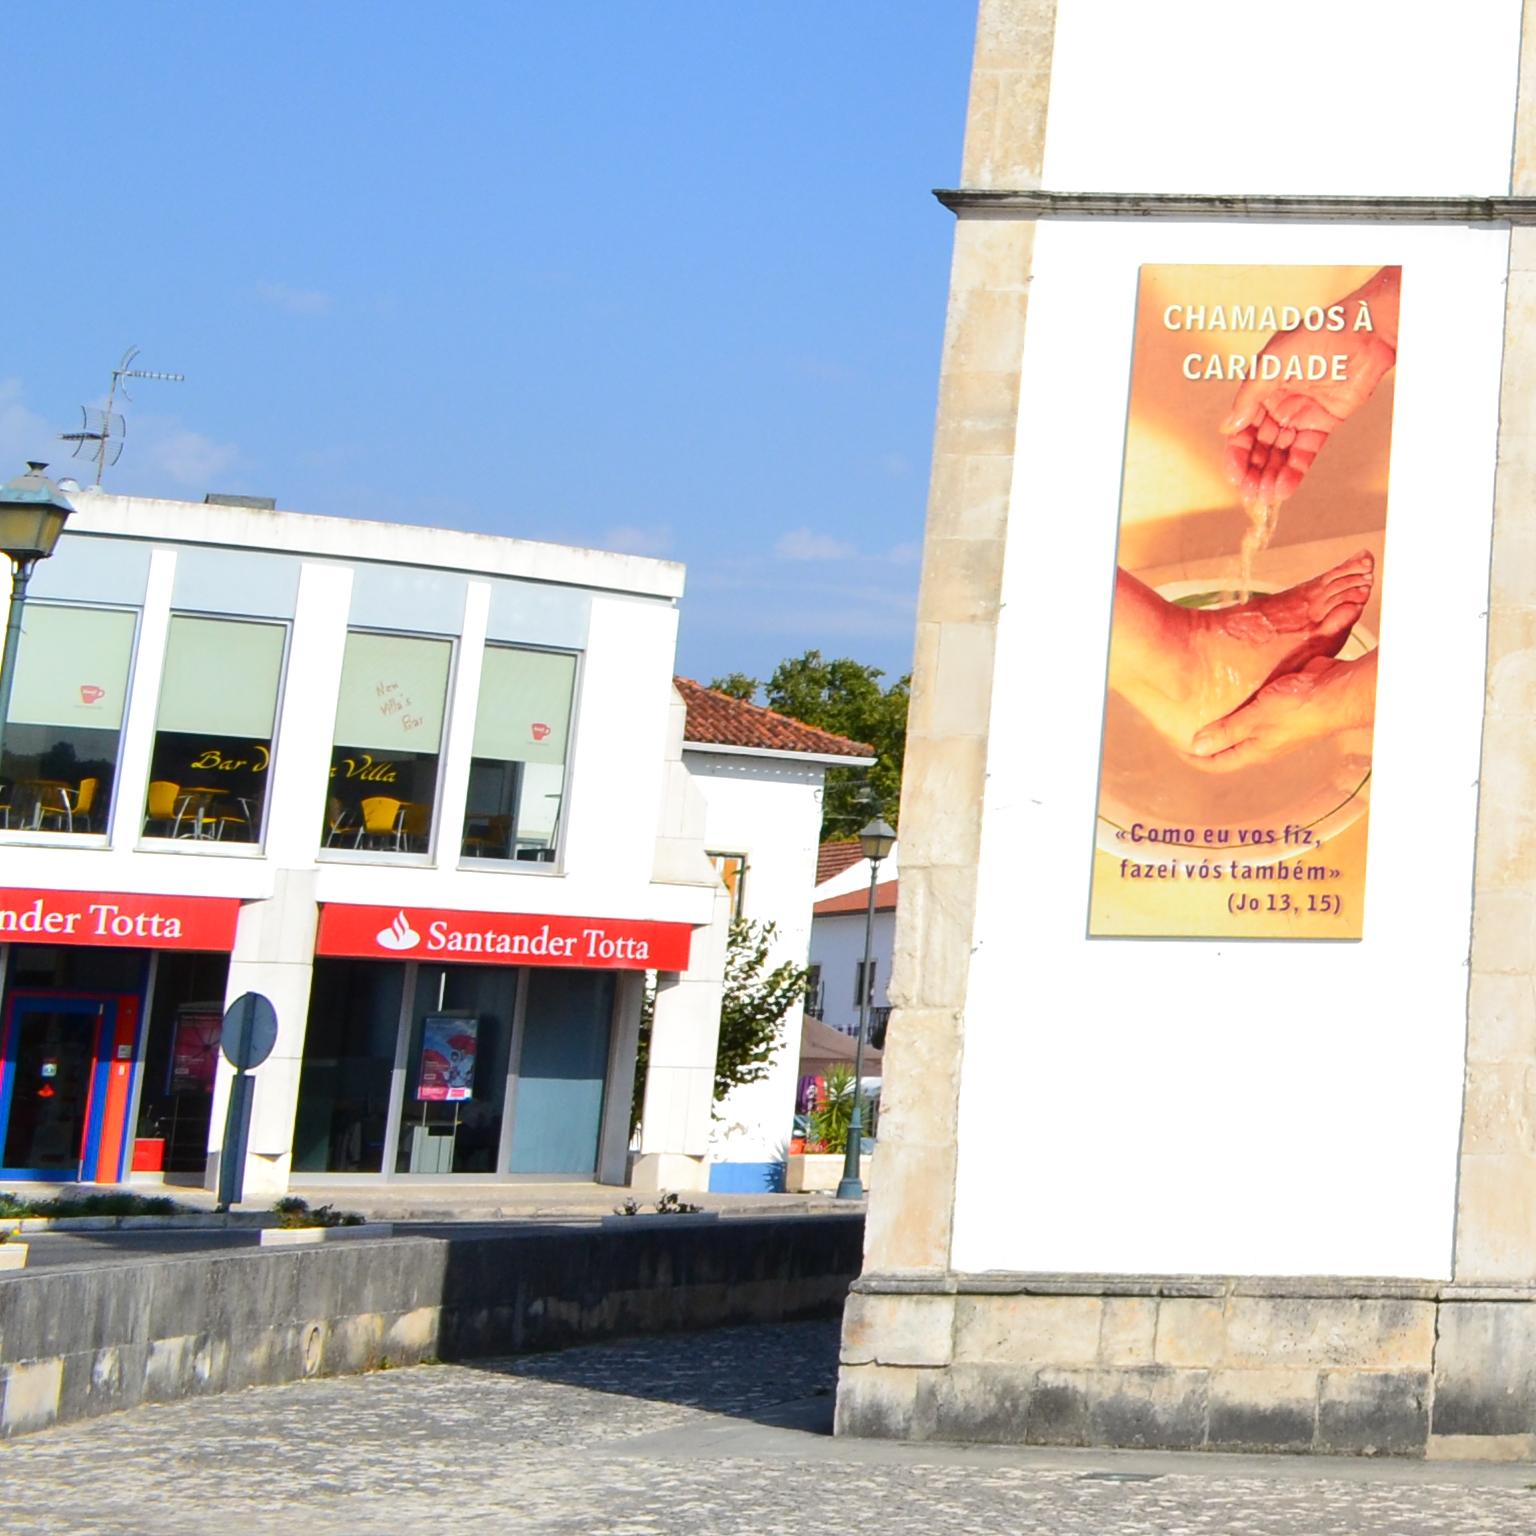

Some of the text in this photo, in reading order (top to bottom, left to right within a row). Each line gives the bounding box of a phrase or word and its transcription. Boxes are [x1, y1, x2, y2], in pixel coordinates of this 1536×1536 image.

[1163, 300, 1374, 332] CHAMADOS À
[1183, 353, 1349, 381] CARIDADE
[191, 750, 247, 771] Bar
[343, 755, 397, 783] Villa
[1203, 828, 1229, 843] eu
[1238, 829, 1275, 844] vos
[1283, 825, 1321, 848] fiz,
[1120, 859, 1177, 878] fazei
[1185, 860, 1222, 879] vós
[1227, 893, 1342, 914] (Jo 13, 15)
[89, 904, 183, 938] Totta
[427, 921, 650, 960] Santander Totta
